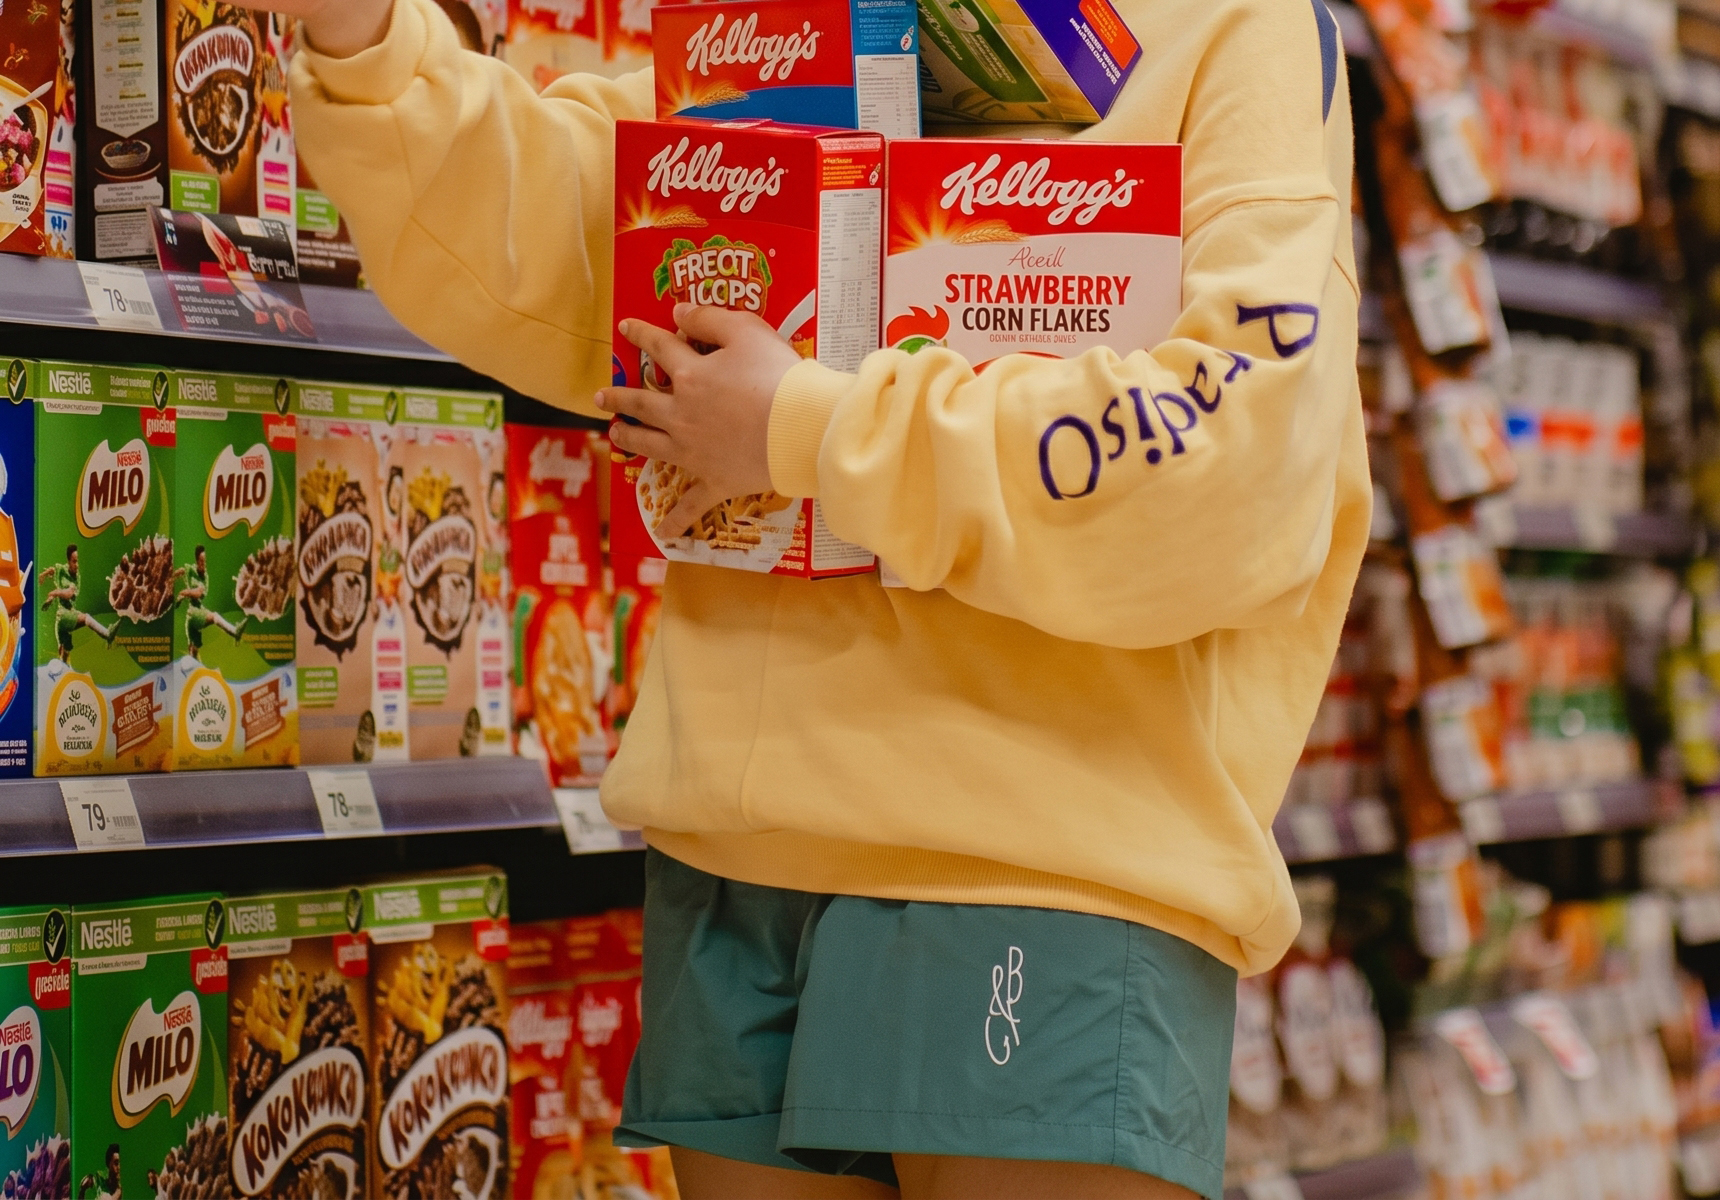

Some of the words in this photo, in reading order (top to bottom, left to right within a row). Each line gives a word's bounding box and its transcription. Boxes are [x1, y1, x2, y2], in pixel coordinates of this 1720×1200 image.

[685, 12, 821, 82] Kellogg's
[648, 136, 784, 213] Kellogg's
[940, 154, 1138, 225] Kellogg's
[945, 274, 1132, 305] STRAWBERRY
[962, 307, 1023, 332] CORN
[1030, 308, 1111, 333] FLAKES
[88, 467, 144, 513] MILO
[214, 471, 268, 515] MILO
[81, 802, 107, 832] 79
[81, 918, 134, 951] Nestlé
[126, 1026, 195, 1097] MILO
